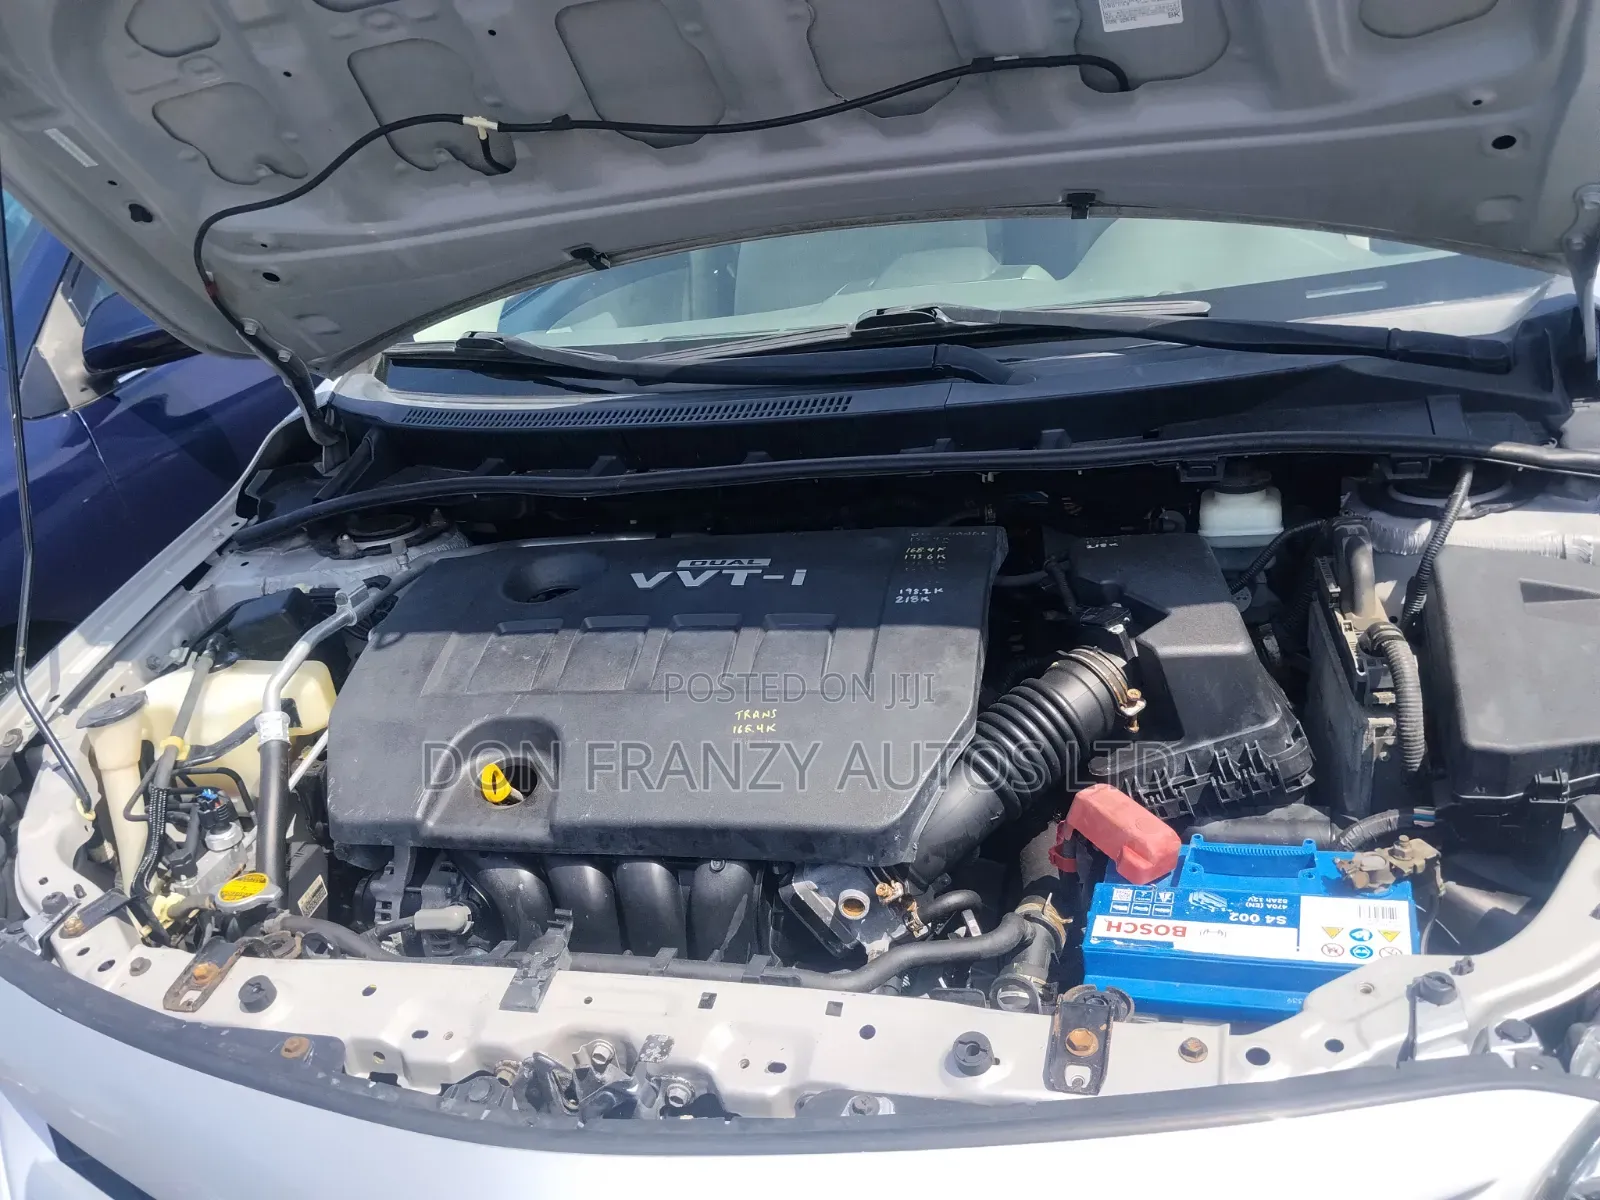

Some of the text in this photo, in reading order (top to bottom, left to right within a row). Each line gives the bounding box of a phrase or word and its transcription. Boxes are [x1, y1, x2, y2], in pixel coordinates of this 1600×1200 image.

[688, 559, 763, 567] DUAL
[735, 709, 777, 720] TRANS
[1245, 901, 1264, 909] (EN)
[1228, 911, 1287, 925] S4 002
[1106, 920, 1187, 938] BOSCH
